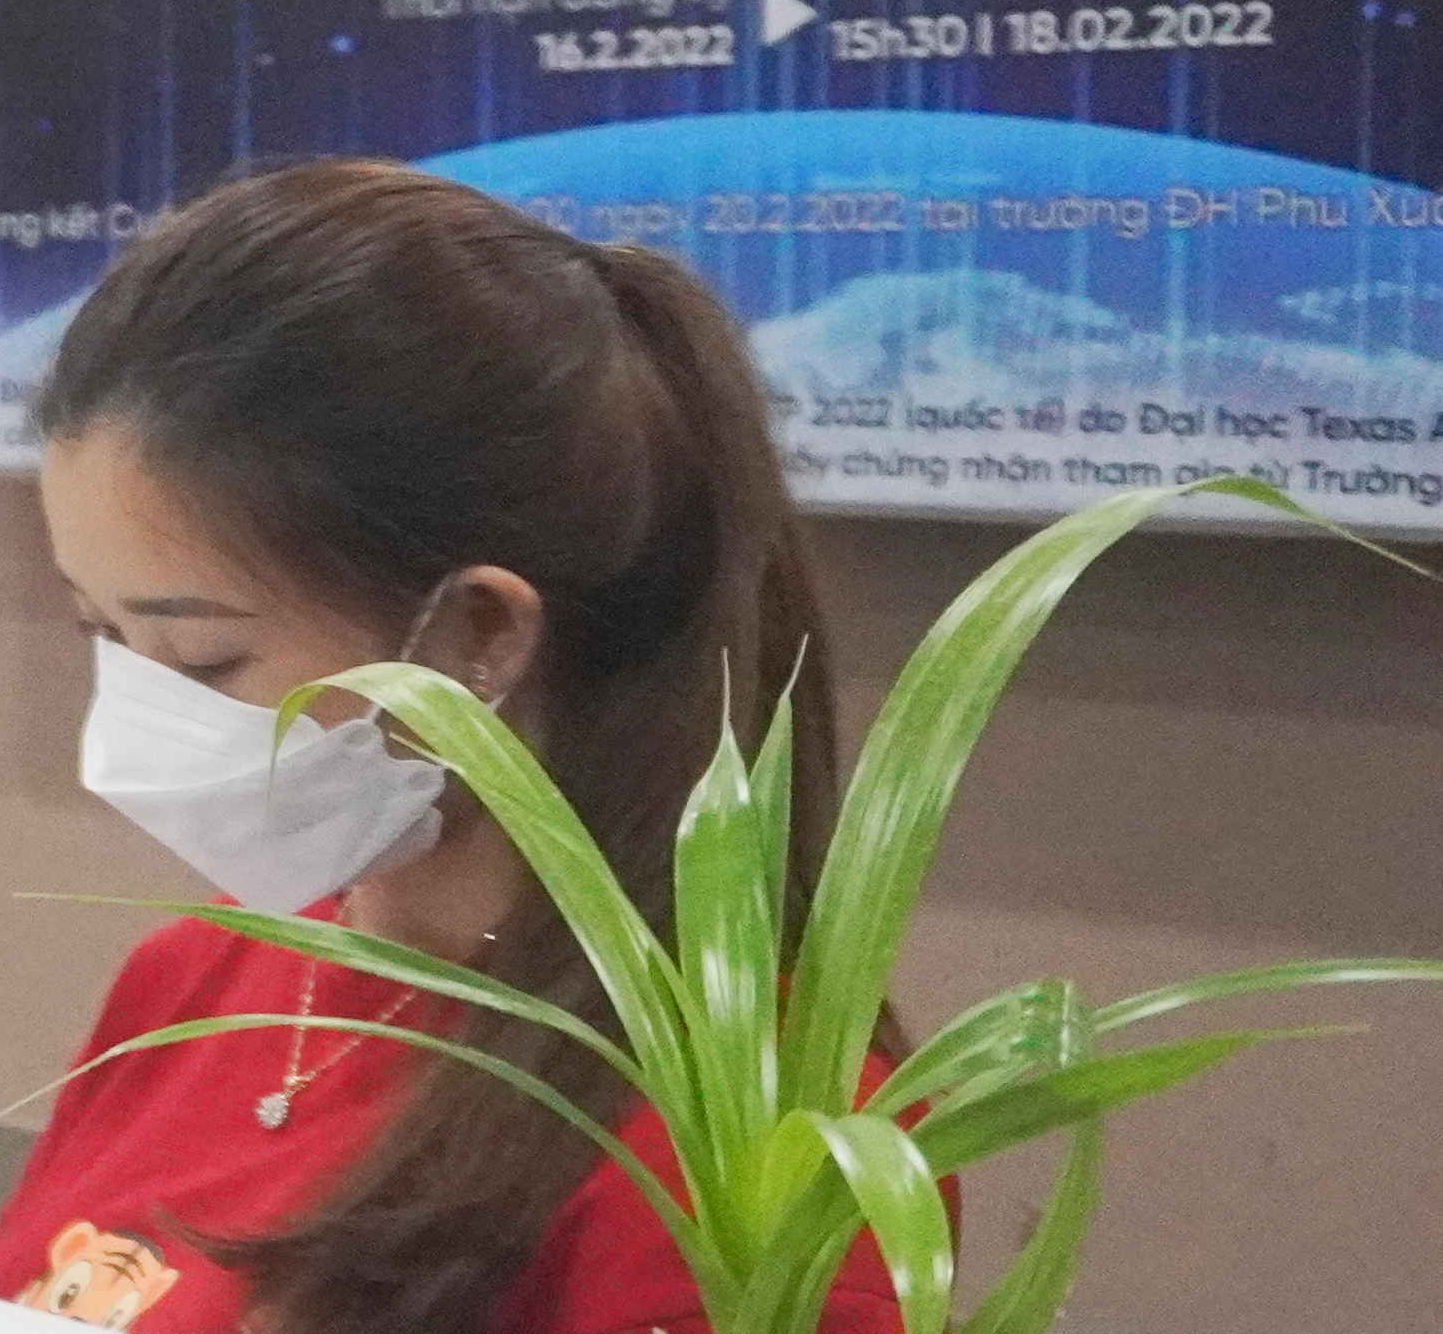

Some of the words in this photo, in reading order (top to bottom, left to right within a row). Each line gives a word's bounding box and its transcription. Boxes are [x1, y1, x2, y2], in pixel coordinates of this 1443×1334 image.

[831, 15, 969, 61] 15h30
[1003, 0, 1273, 54] 18.02.2022
[1296, 405, 1418, 443] Texas
